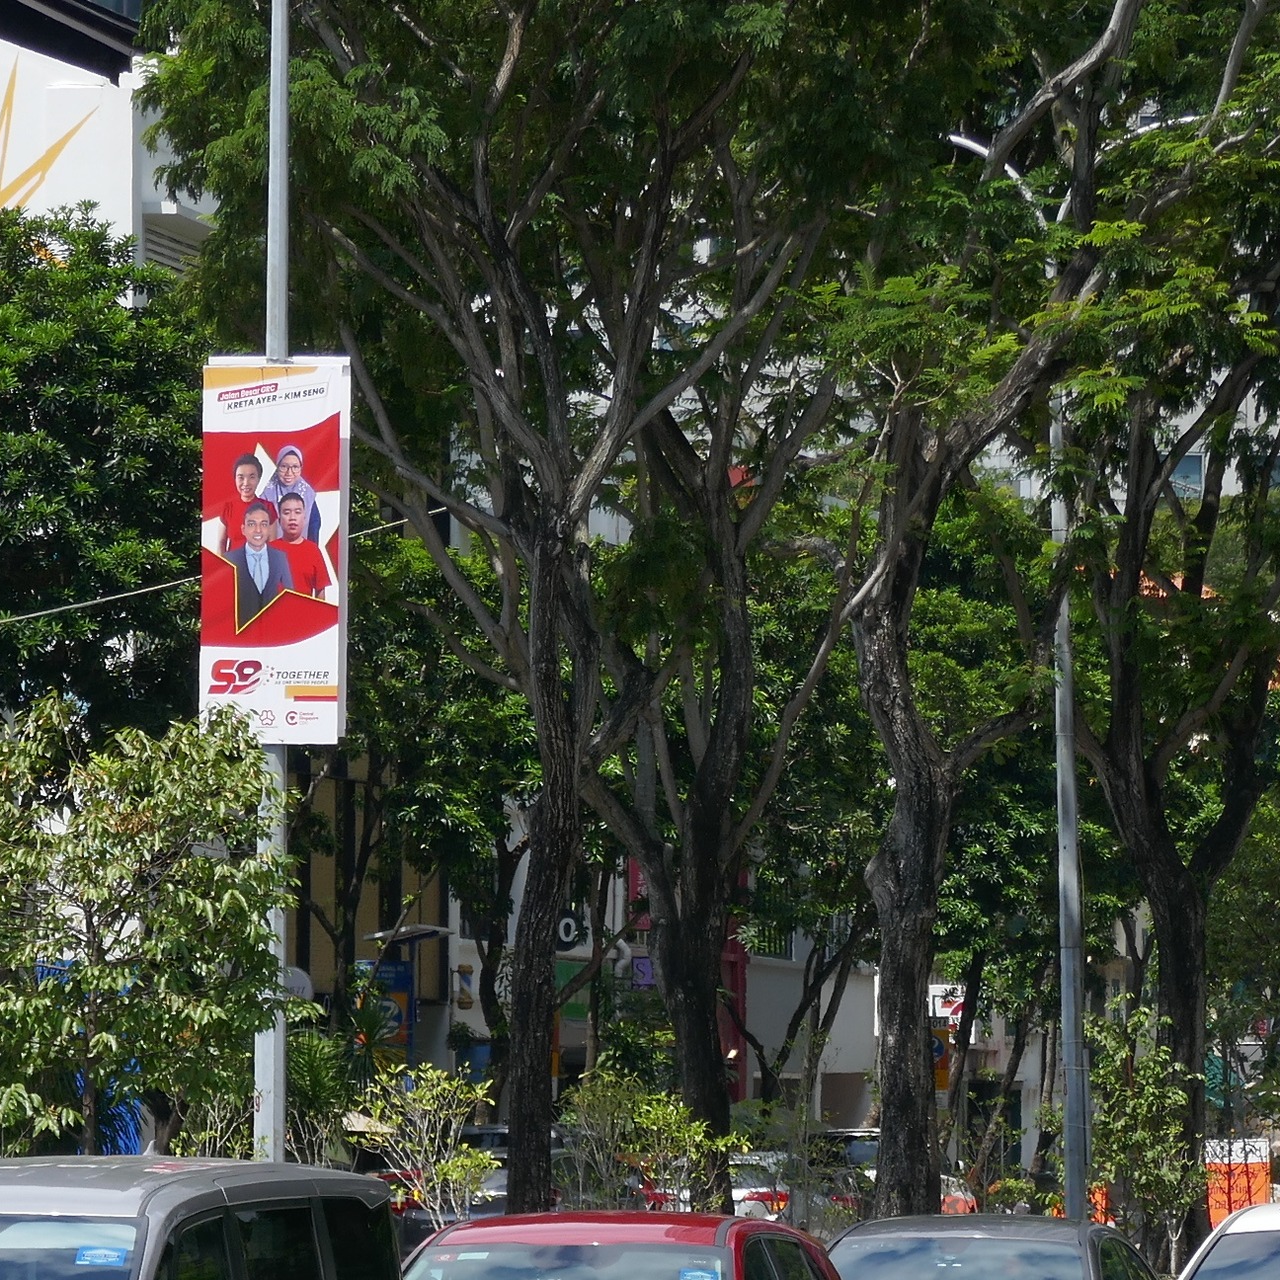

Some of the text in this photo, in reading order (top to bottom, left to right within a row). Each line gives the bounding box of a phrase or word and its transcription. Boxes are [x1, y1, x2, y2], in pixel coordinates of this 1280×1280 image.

[220, 391, 240, 401] Jalan
[240, 388, 261, 399] Besar
[227, 399, 254, 411] KRETA
[255, 394, 278, 405] AYER
[284, 390, 301, 400] KIM
[302, 387, 325, 398] SENG
[275, 671, 330, 680] TOGETHER
